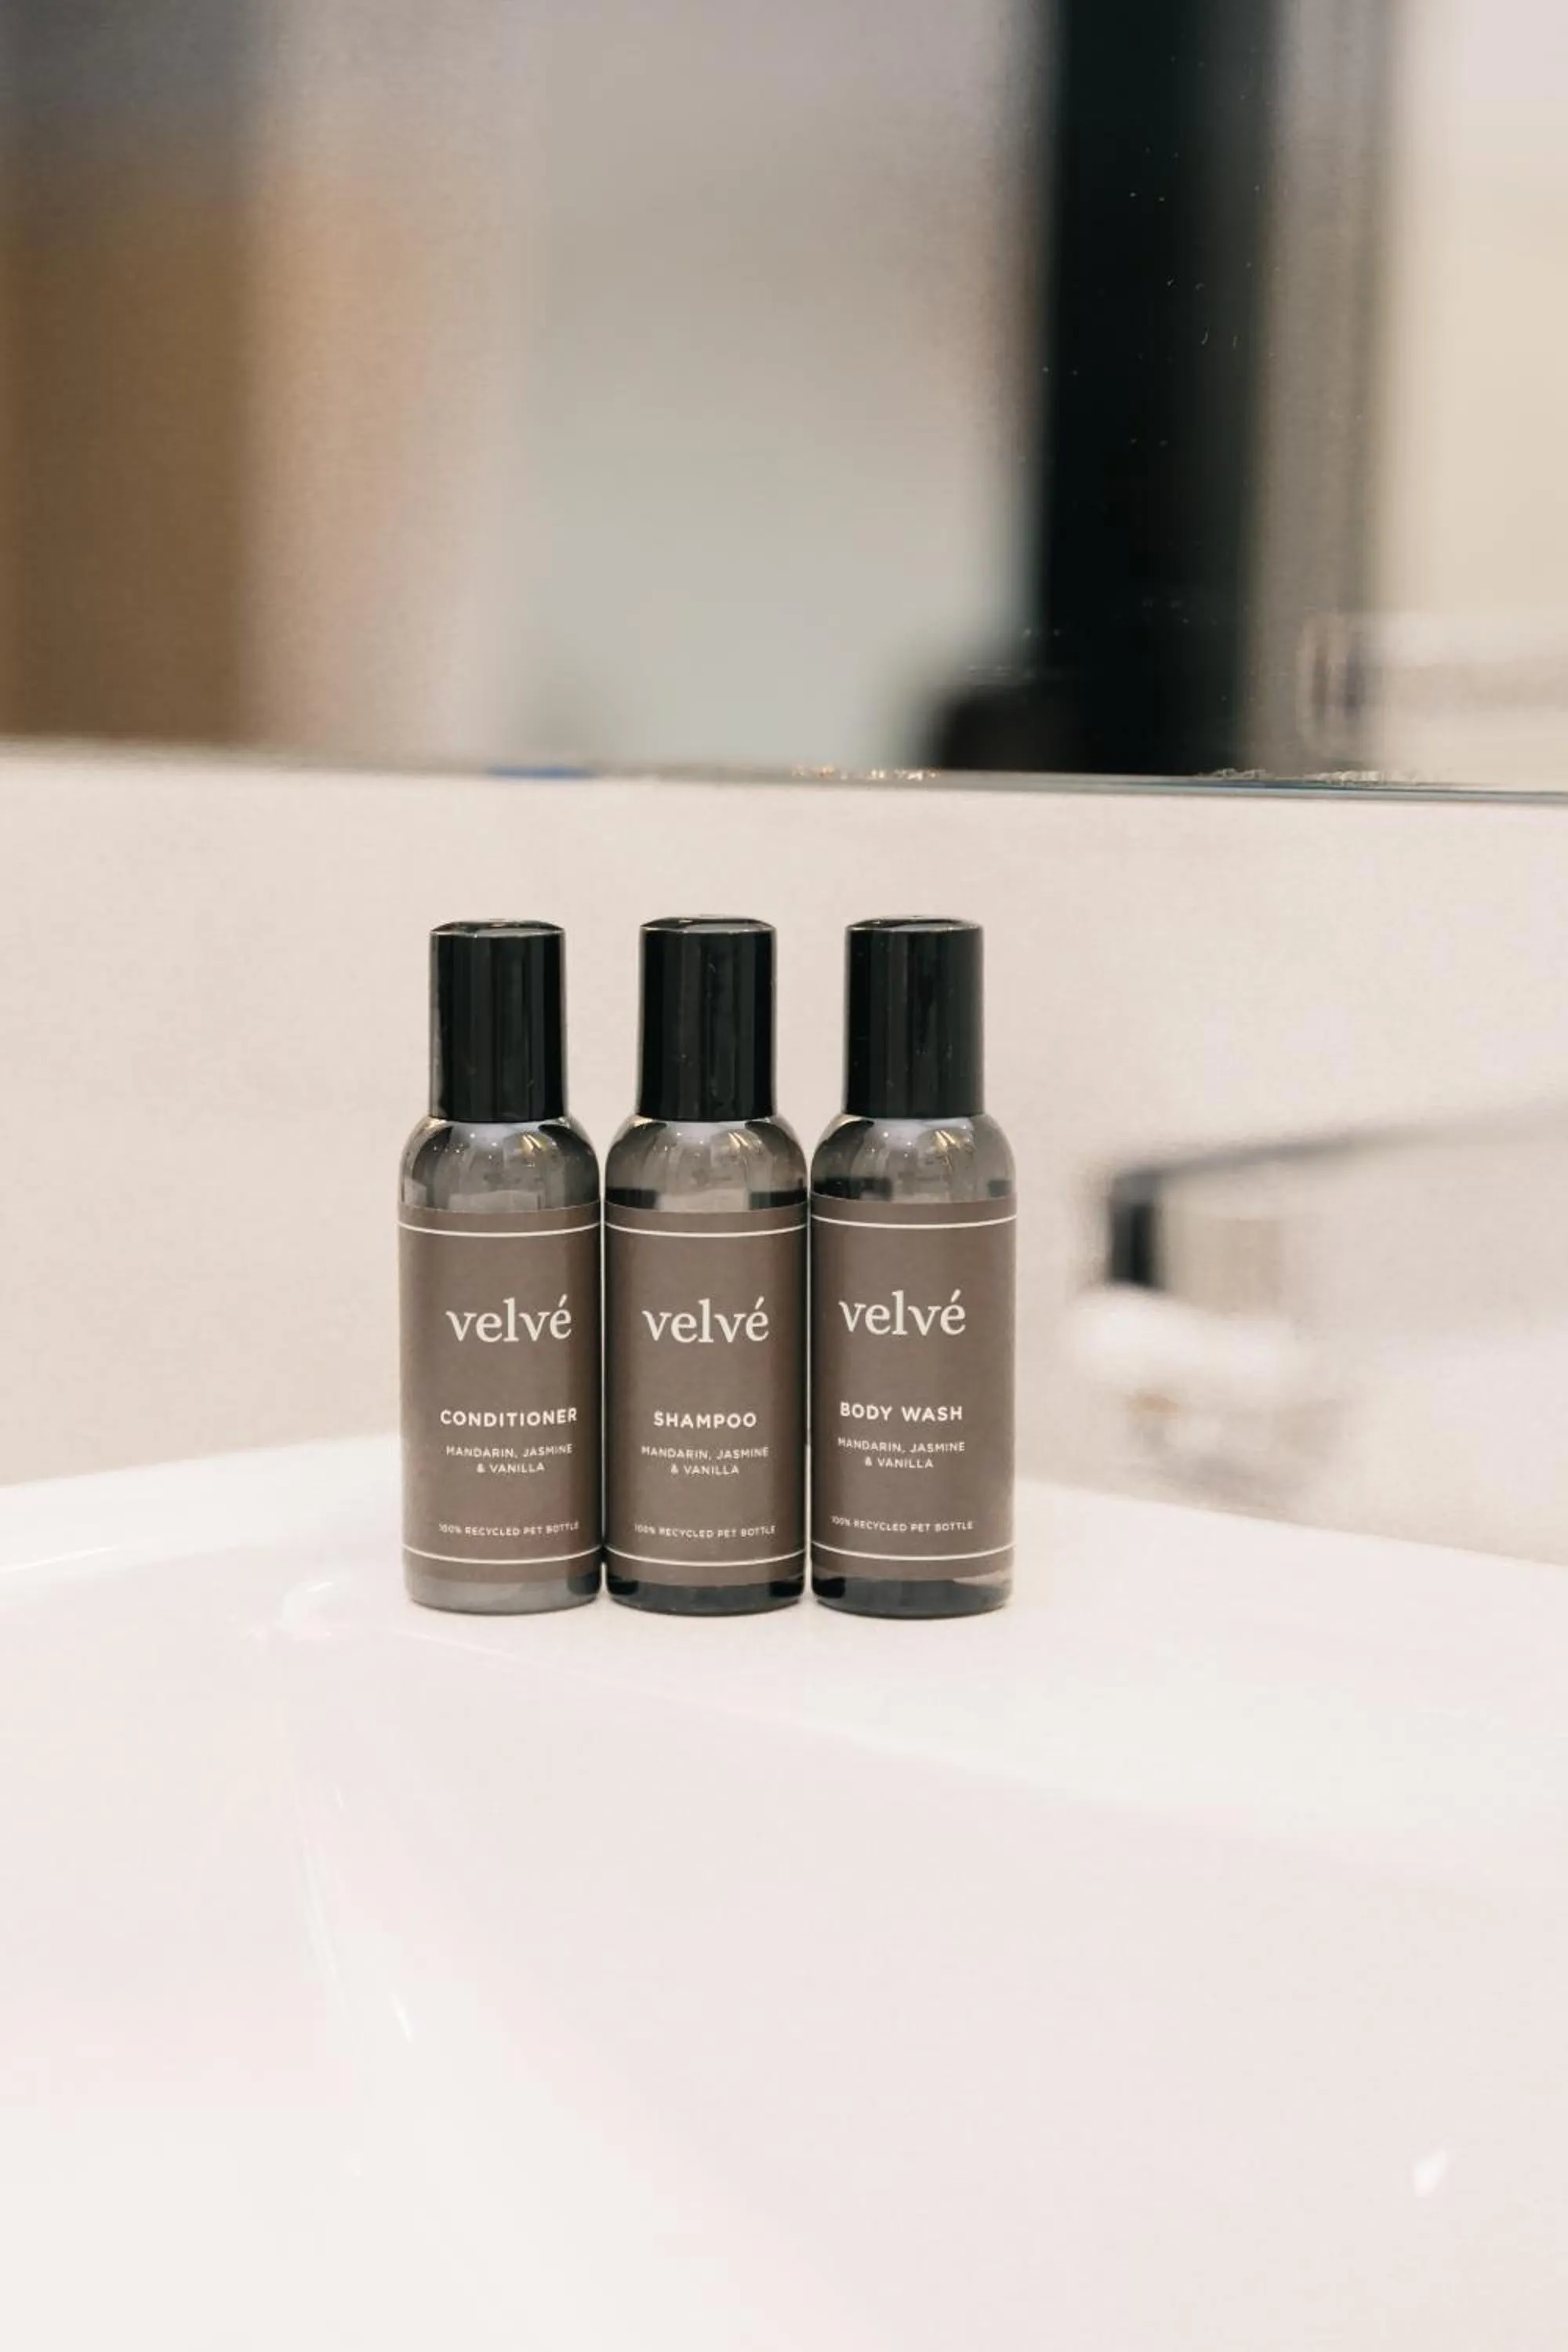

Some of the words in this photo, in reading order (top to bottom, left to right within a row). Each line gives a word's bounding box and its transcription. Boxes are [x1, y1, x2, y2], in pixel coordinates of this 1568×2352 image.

[445, 1294, 572, 1343] velvé
[642, 1296, 770, 1344] velvé
[838, 1289, 967, 1337] velvé
[440, 1407, 578, 1428] CONDITIONER
[653, 1410, 757, 1429] SHAMPOO
[840, 1401, 893, 1421] BODY
[901, 1405, 963, 1423] WASH
[445, 1445, 518, 1459] MANDARIN,
[523, 1443, 573, 1458] JASMINE
[641, 1445, 712, 1461] MANDARIN,
[717, 1446, 769, 1461] JASMINE
[837, 1436, 906, 1454] MANDARIN,
[909, 1441, 966, 1454] JASMINE
[476, 1462, 486, 1474] &
[489, 1461, 546, 1474] VANILLA
[670, 1463, 680, 1475] &
[684, 1464, 739, 1476] VANILLA
[864, 1455, 873, 1468] &
[877, 1457, 935, 1469] VANILLA
[464, 1526, 521, 1537] RECYCLED
[523, 1526, 543, 1536] PET
[546, 1520, 579, 1534] BOTTLE
[634, 1523, 656, 1535] 100%
[659, 1526, 714, 1539] RECYCLED
[717, 1528, 737, 1539] PET
[740, 1525, 776, 1537] BOTTLE
[853, 1518, 907, 1533] RECYCLED
[909, 1523, 931, 1533] PET
[935, 1520, 974, 1533] BOTTLE
